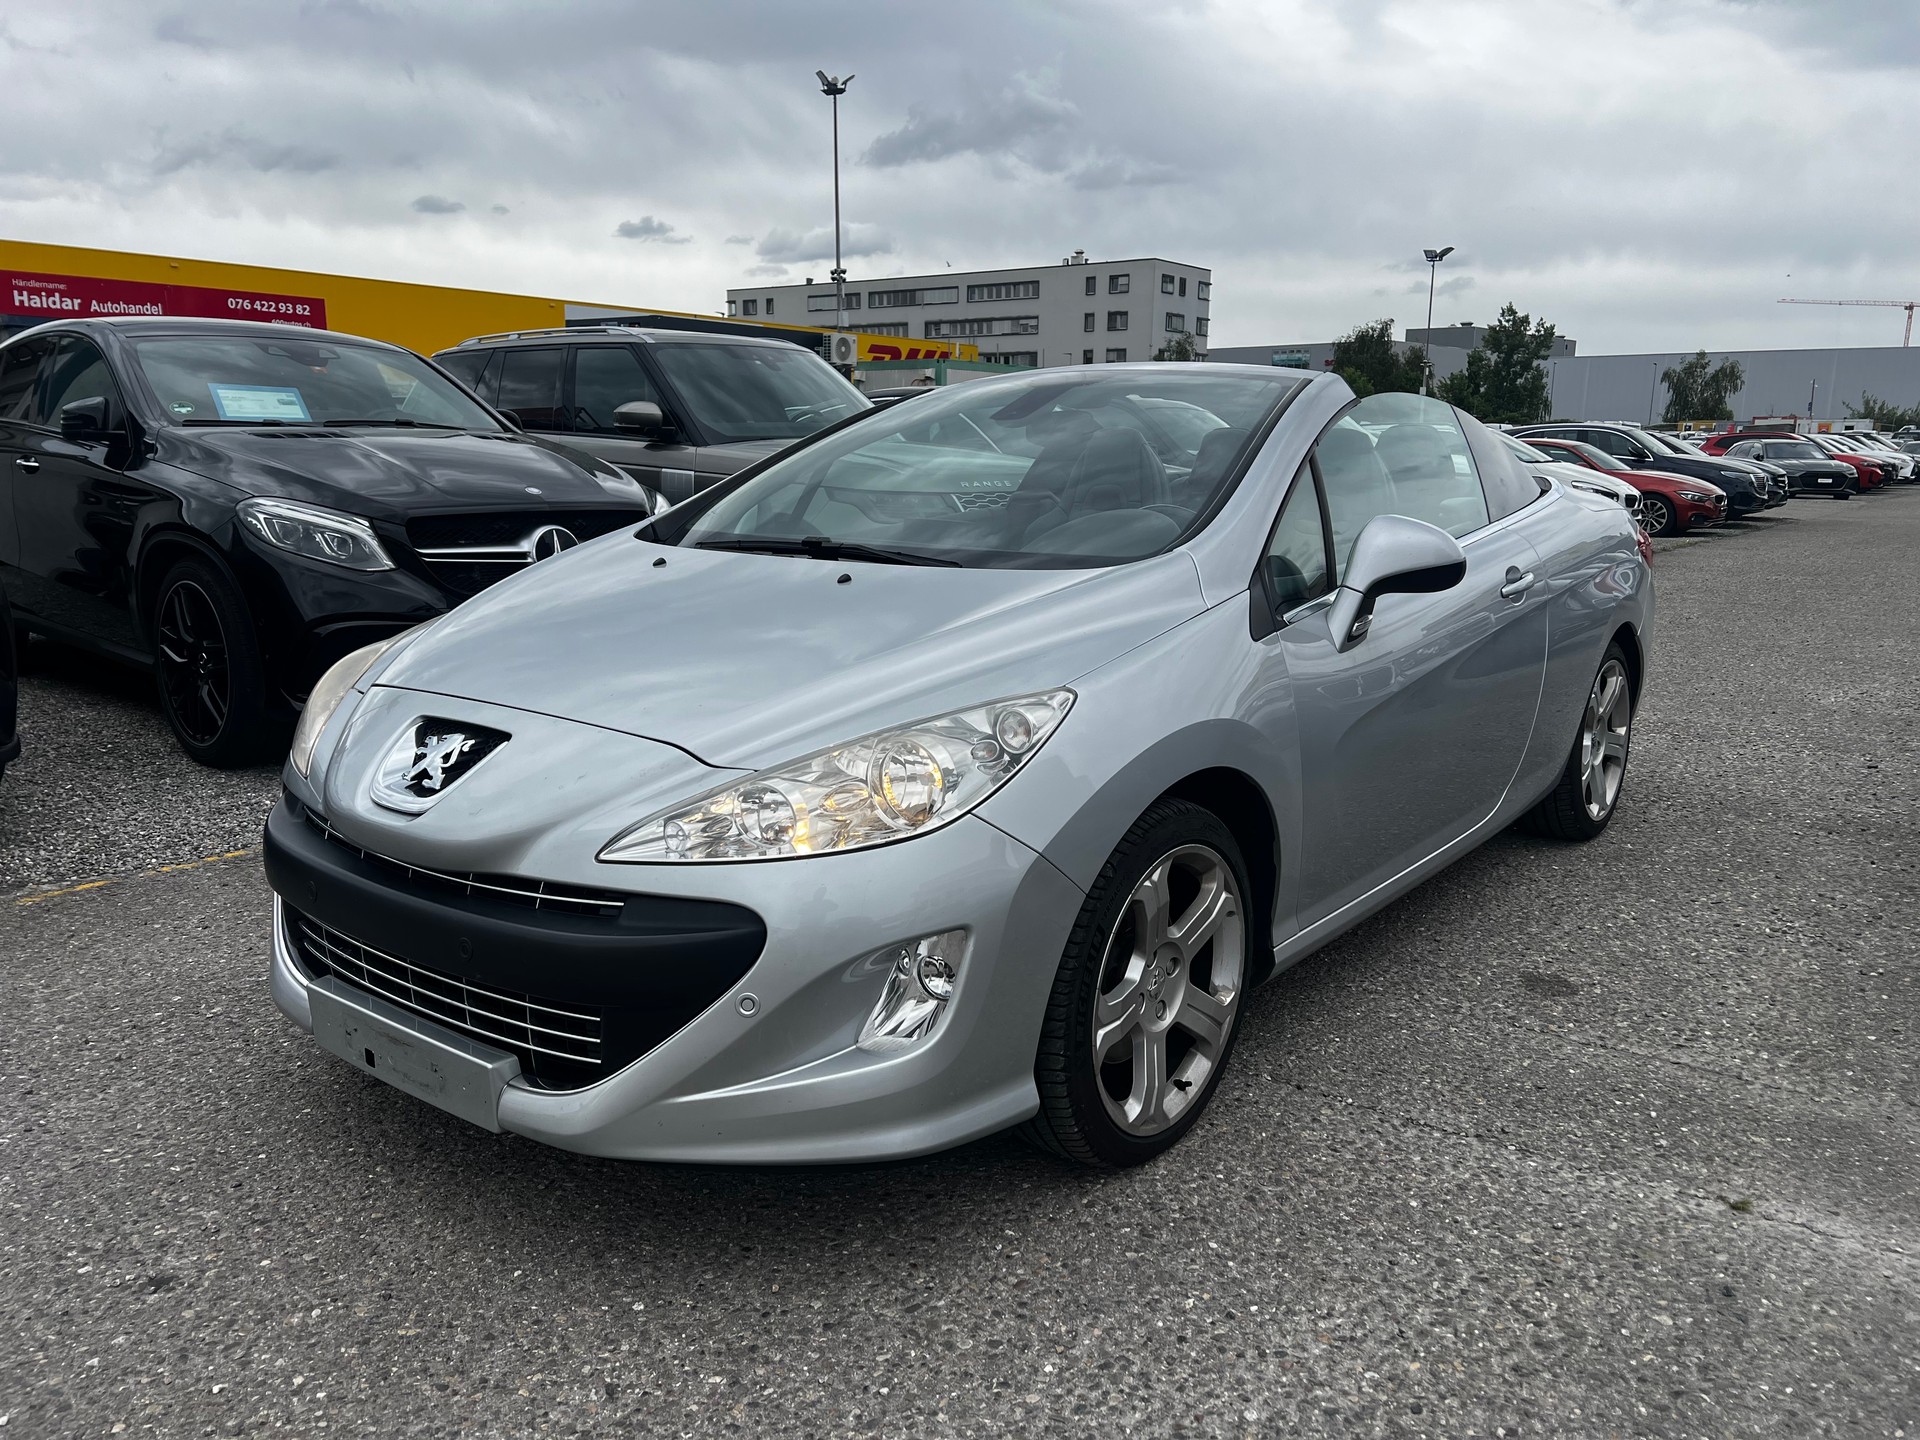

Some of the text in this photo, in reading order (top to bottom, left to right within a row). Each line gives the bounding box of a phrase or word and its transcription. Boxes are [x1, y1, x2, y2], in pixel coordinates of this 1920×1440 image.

[12, 278, 67, 290] Händlername:
[13, 290, 163, 315] Haidar Autohandel
[228, 298, 311, 316] 076 422 93 82
